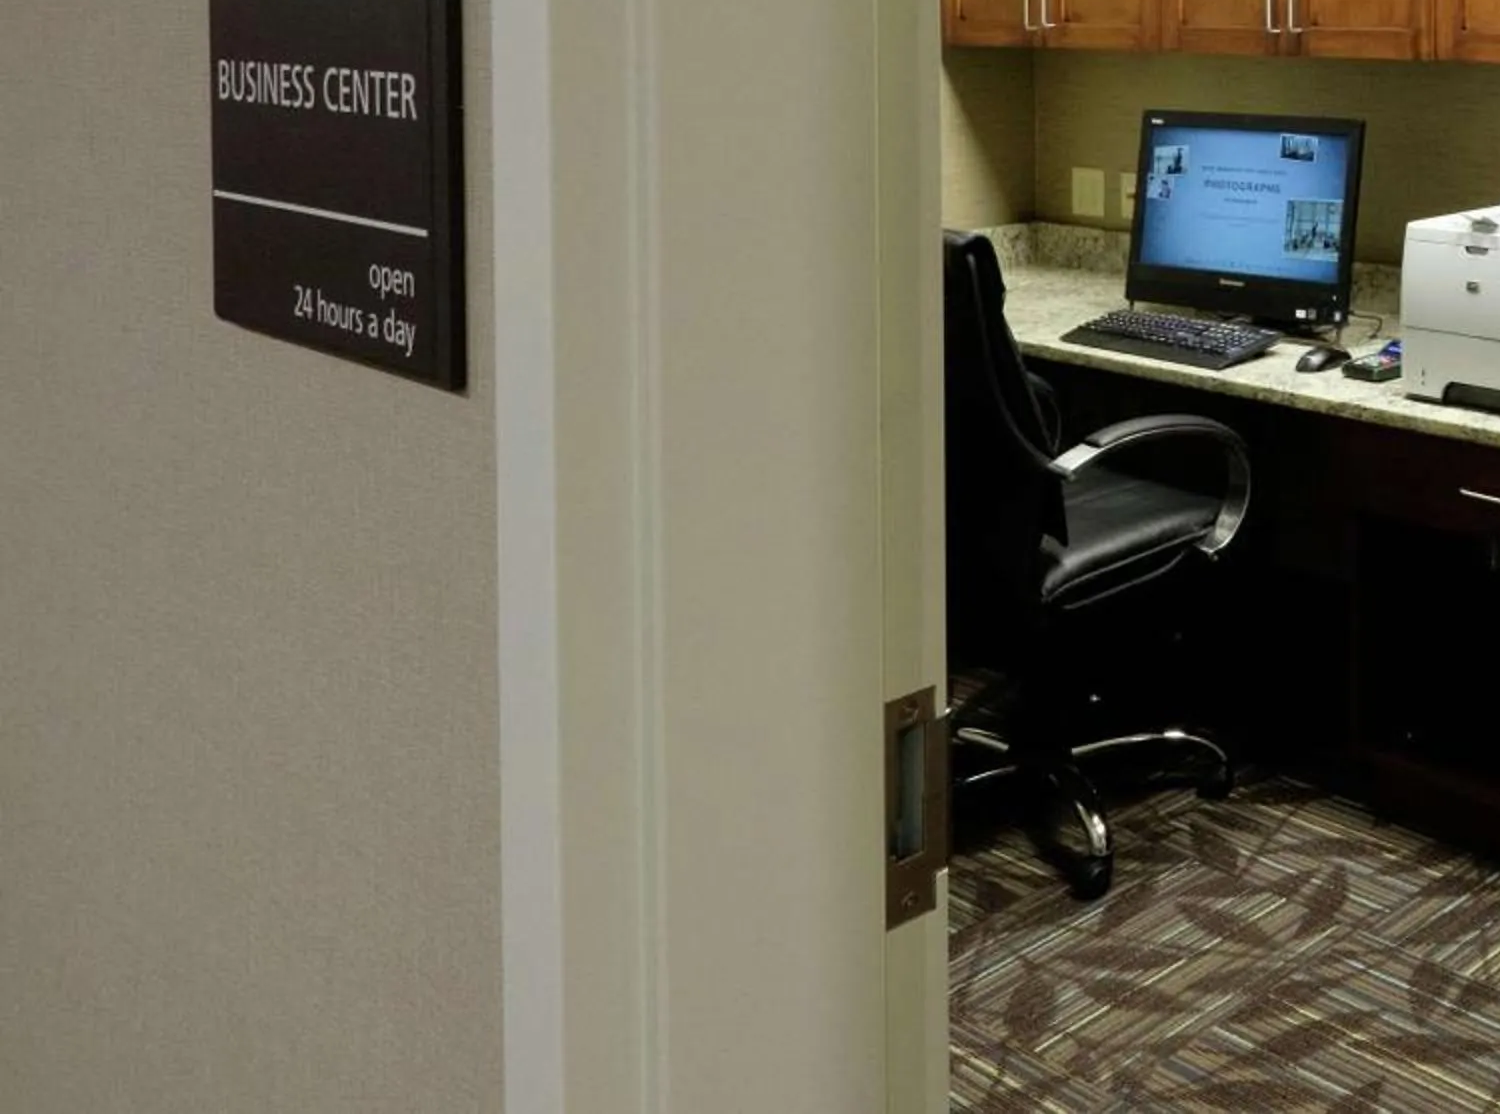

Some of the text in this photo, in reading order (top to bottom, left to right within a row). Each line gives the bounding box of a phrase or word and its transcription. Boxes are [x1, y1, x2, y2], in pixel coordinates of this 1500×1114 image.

[218, 59, 418, 121] BUSINESS CENTER
[368, 262, 415, 301] open
[293, 285, 417, 358] 24 hours a day
